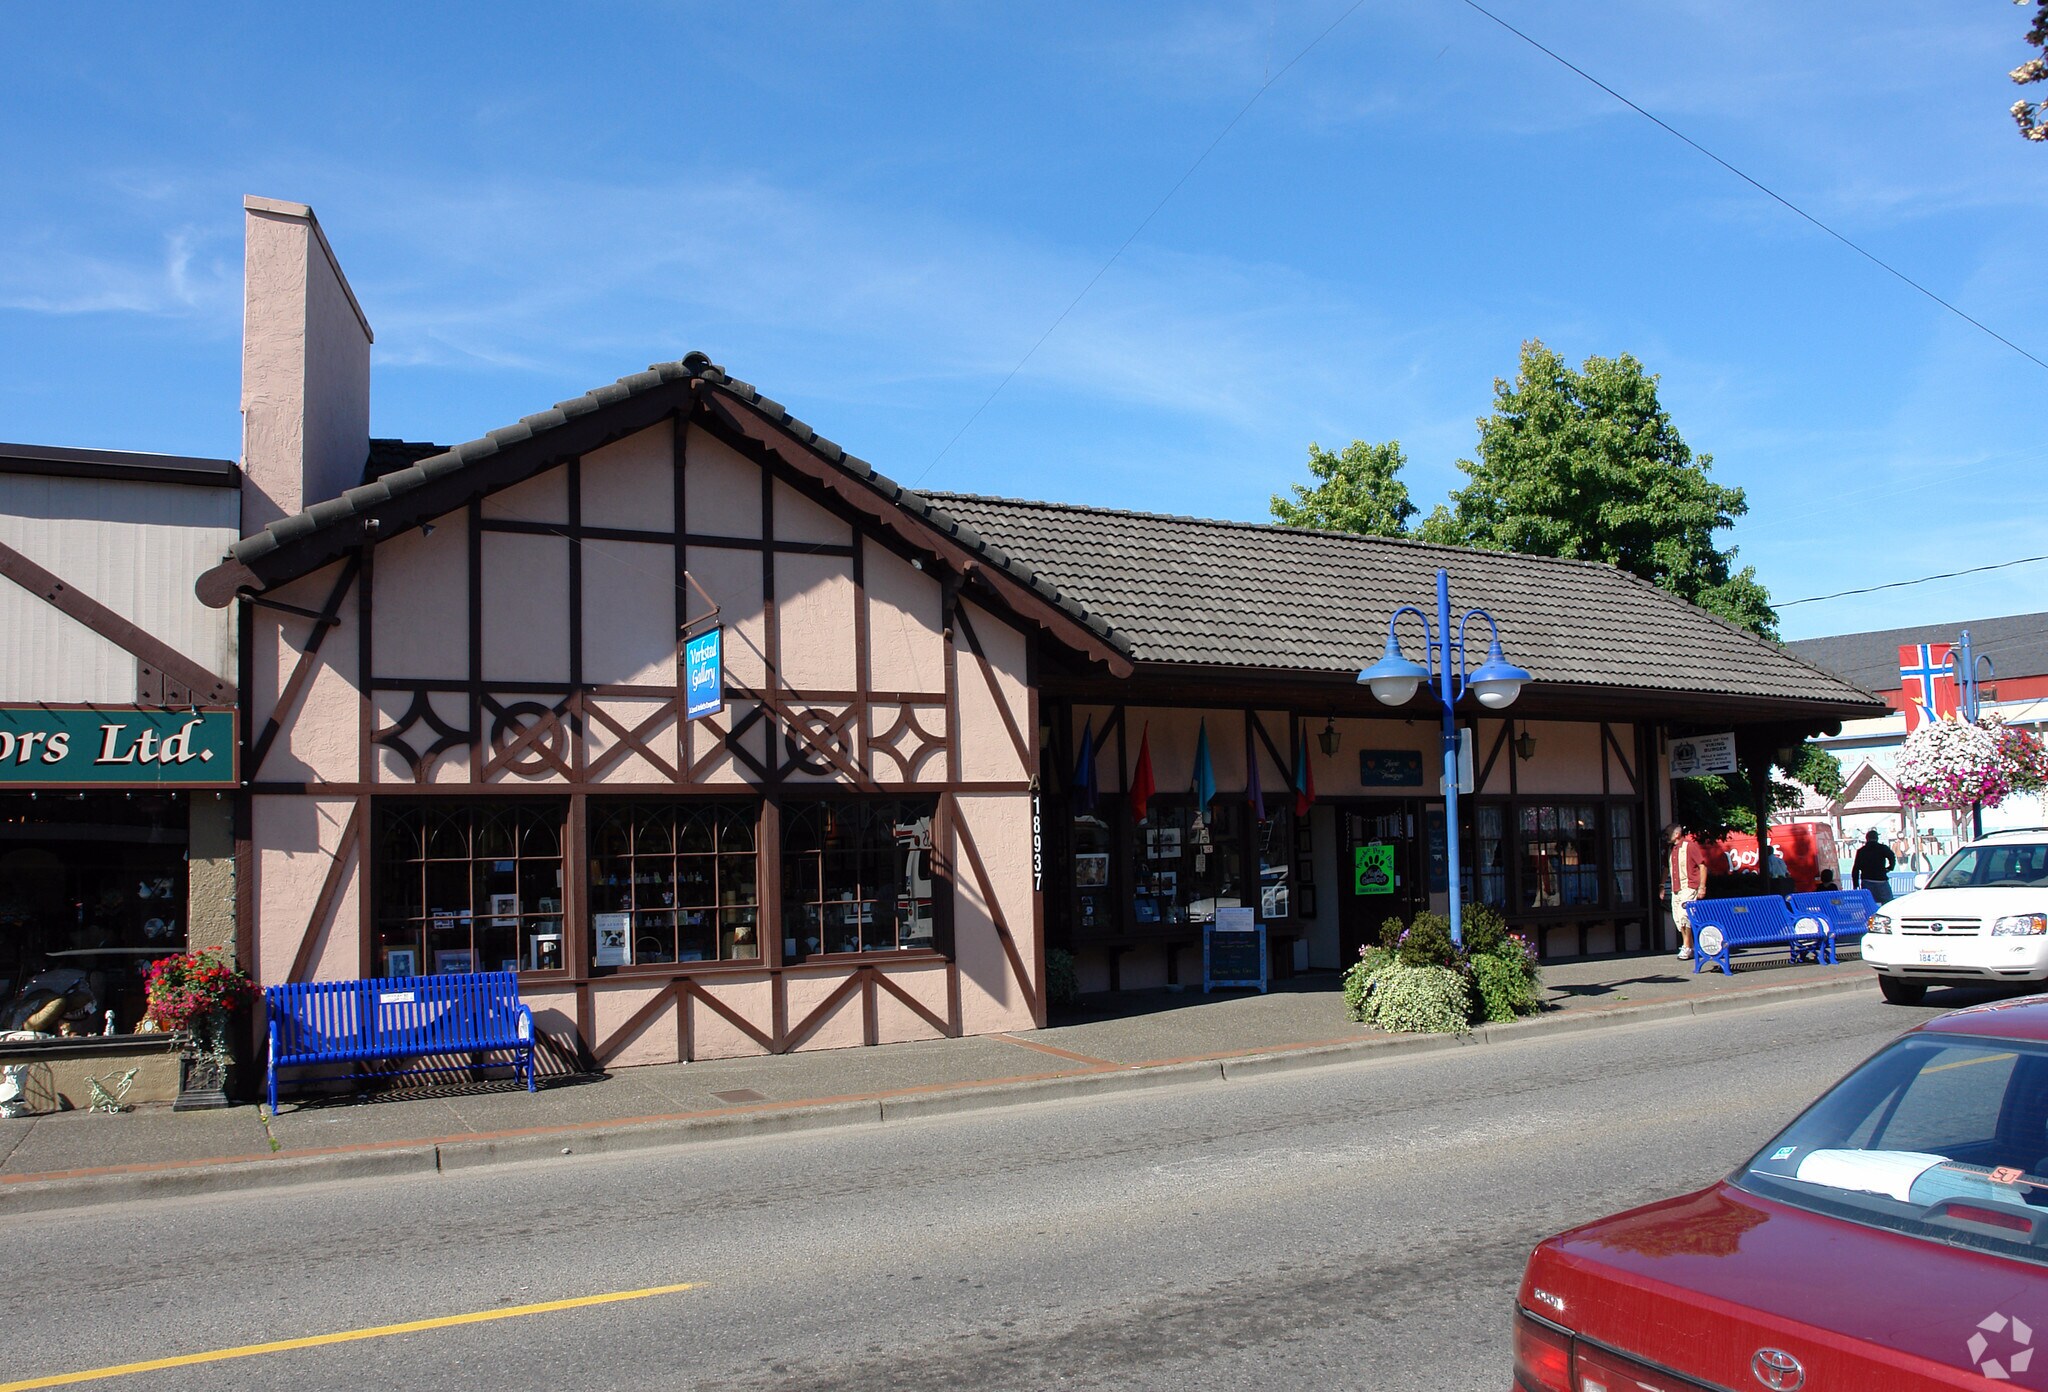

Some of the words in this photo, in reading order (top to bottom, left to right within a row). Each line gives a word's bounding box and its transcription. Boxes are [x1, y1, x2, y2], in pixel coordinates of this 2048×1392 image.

[692, 662, 717, 692] Gallery
[94, 719, 214, 764] Ltd.
[1028, 773, 1040, 791] A
[1032, 796, 1042, 891] 18937
[1993, 1167, 2017, 1182] SU
